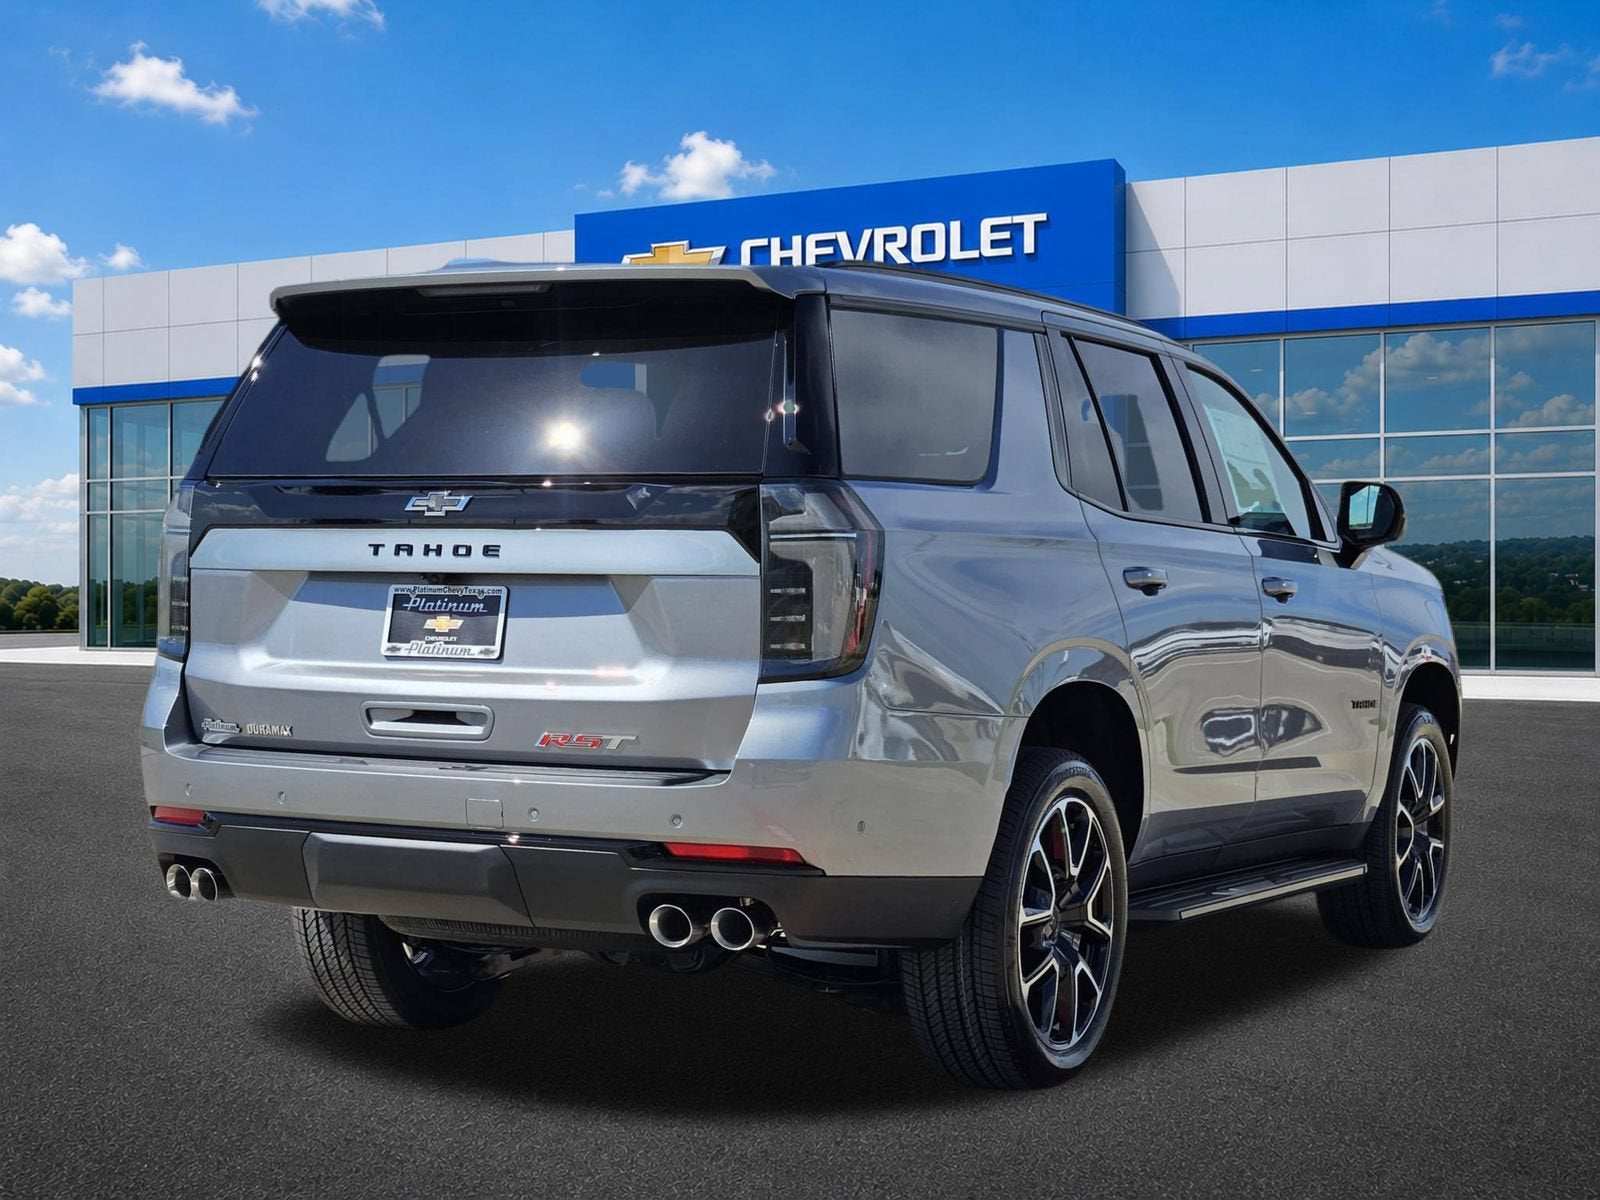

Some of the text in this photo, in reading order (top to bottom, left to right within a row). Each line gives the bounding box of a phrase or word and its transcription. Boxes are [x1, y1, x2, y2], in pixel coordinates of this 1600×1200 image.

[741, 212, 1047, 265] CHEVROLET
[368, 544, 501, 558] TAHOE
[402, 597, 488, 613] Platinum
[404, 641, 475, 656] Platinum
[246, 723, 294, 736] DURAMAX
[534, 731, 638, 750] RST
